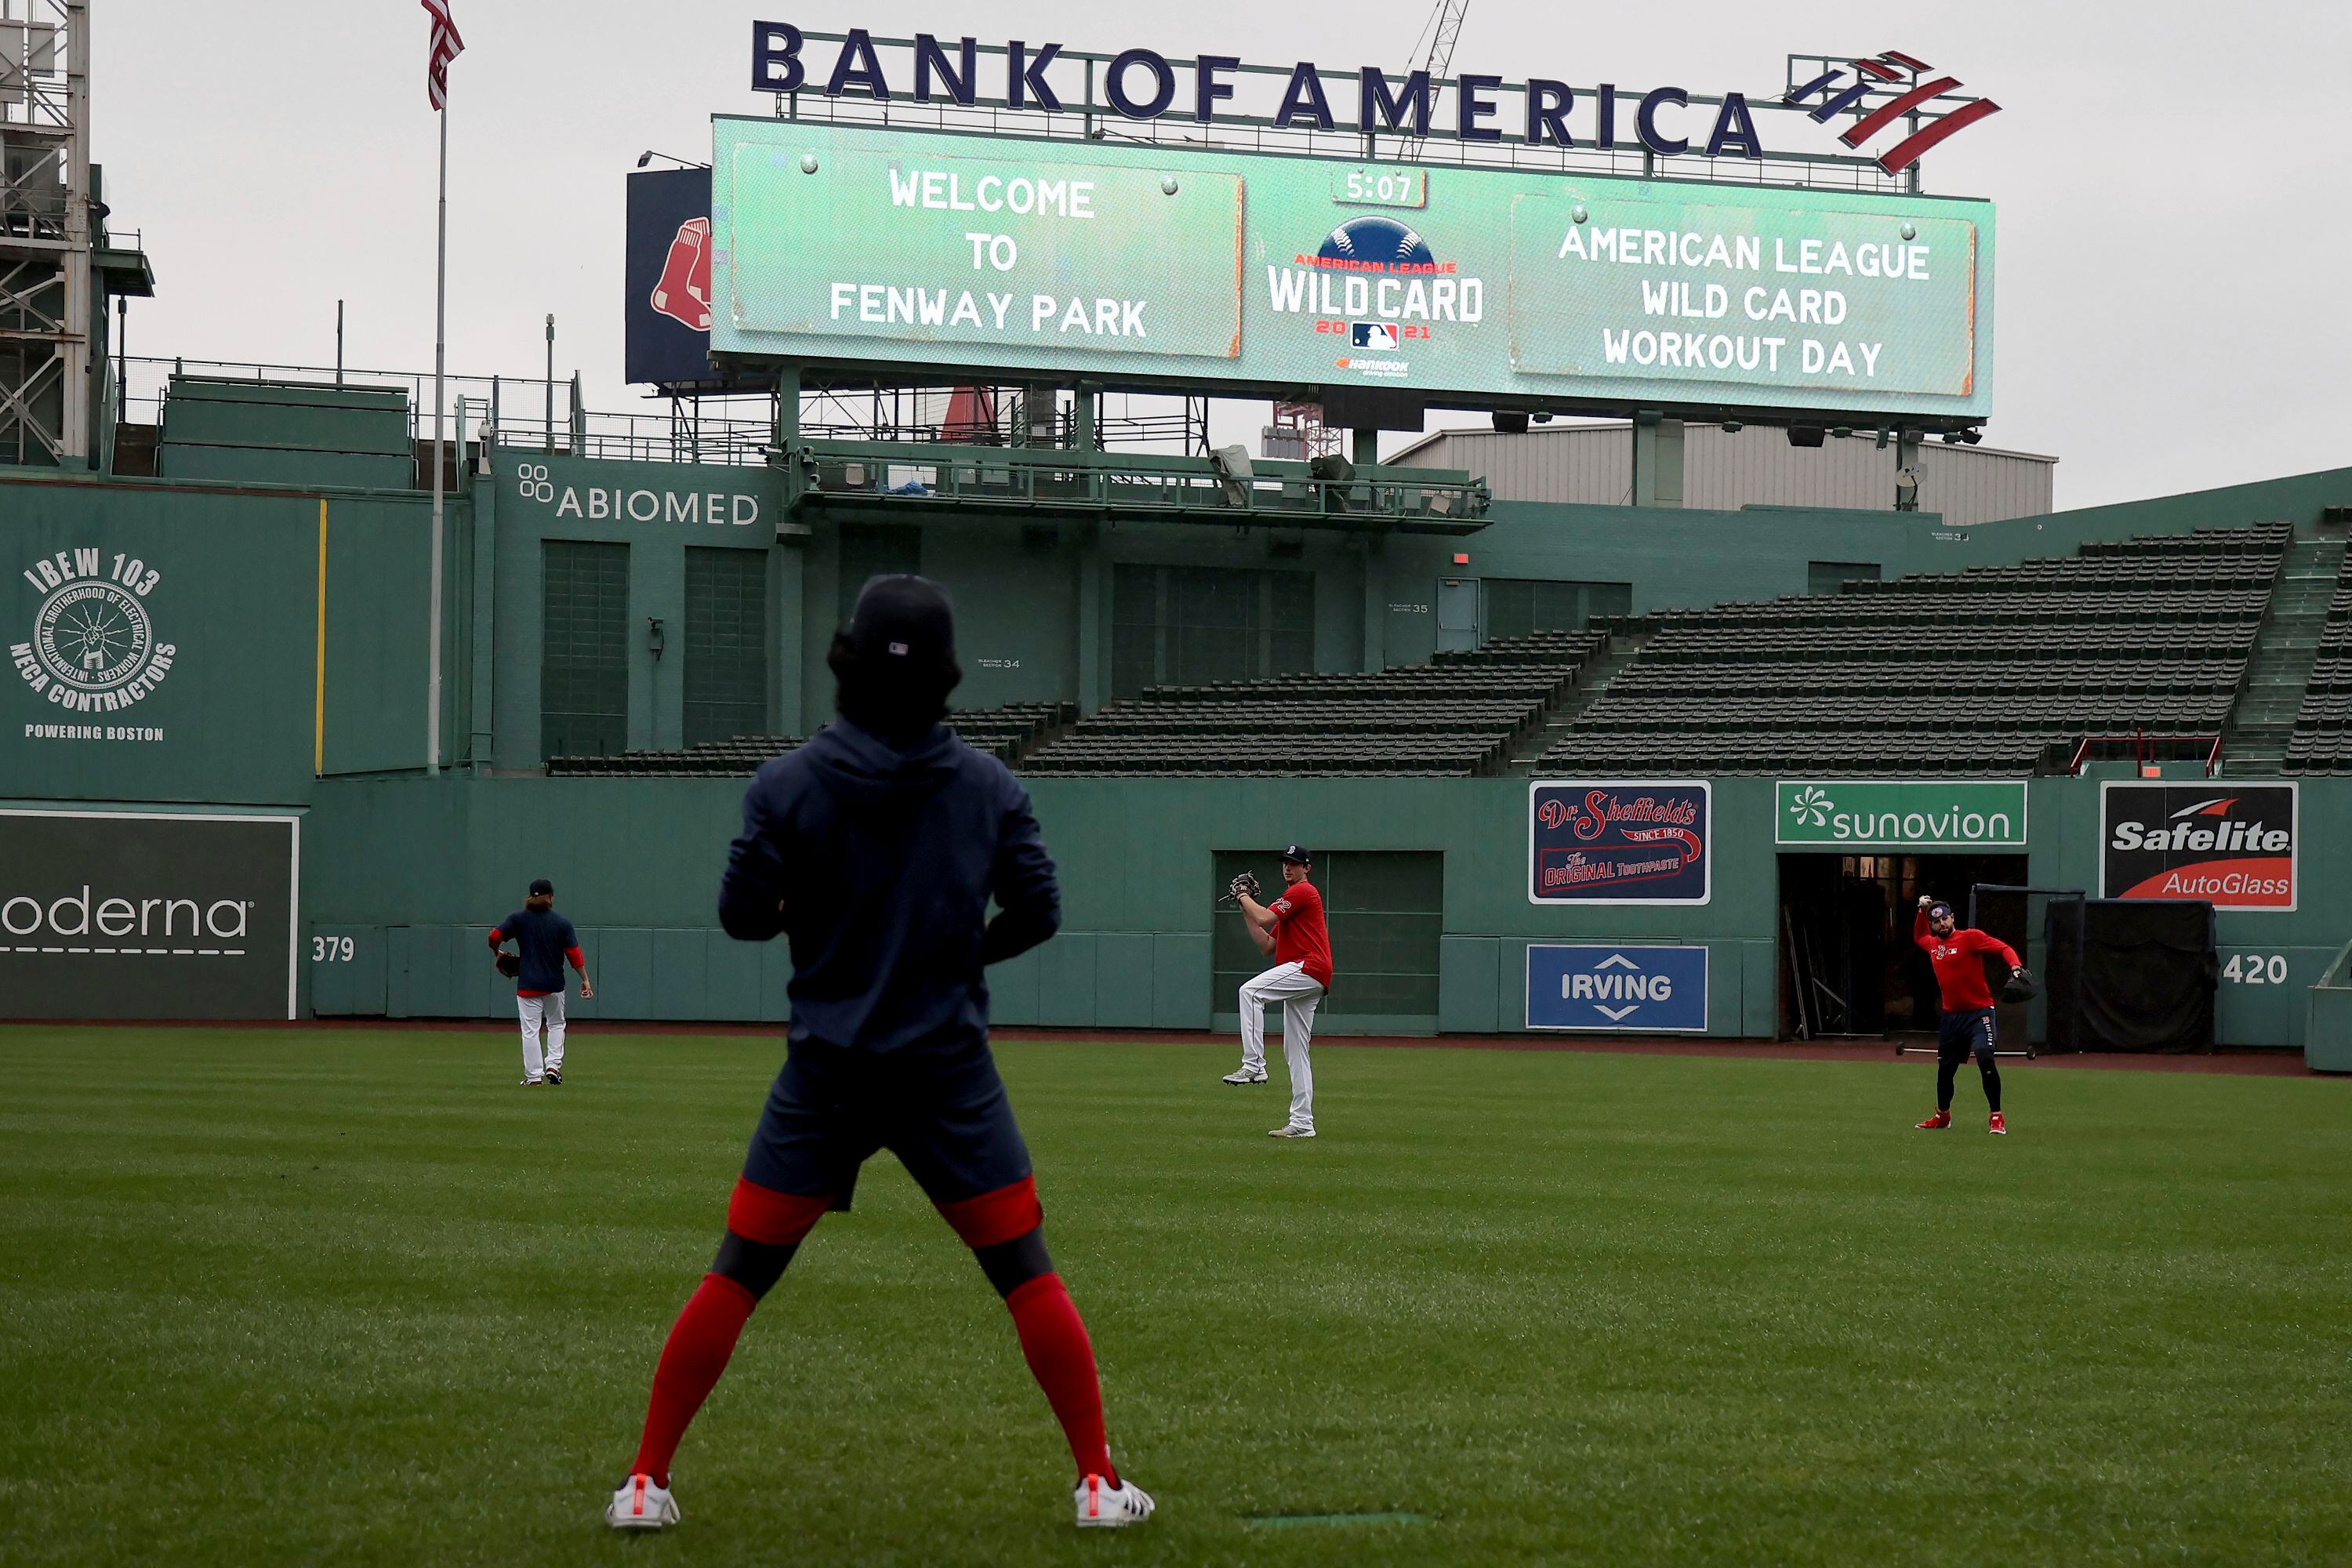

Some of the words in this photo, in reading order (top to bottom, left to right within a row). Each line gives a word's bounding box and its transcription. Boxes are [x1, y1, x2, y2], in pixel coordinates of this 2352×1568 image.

[751, 20, 1064, 114] BANK
[1103, 48, 1241, 124] OF
[1272, 61, 1764, 160] AMERICA
[889, 169, 1094, 219] WELCOME
[1347, 173, 1411, 201] 5:07
[965, 232, 1017, 271] TO
[1294, 254, 1385, 273] AMERICAN
[1389, 262, 1457, 274] LEAGUE
[1558, 225, 1761, 270] AMERICAN
[1776, 238, 1929, 280] LEAGUE
[830, 282, 1014, 329] FENWAY
[1032, 295, 1148, 337] PARK
[1267, 264, 1369, 316] WILD
[1377, 278, 1483, 323] CARD
[1642, 280, 1728, 318] WILD
[1744, 286, 1847, 325] CARD
[1315, 320, 1346, 334] 20
[1404, 325, 1431, 339] 21
[1603, 328, 1786, 372] WORKOUT
[1803, 339, 1882, 377] DAY
[556, 486, 759, 525] ABIOMED
[24, 548, 99, 594] IBEW
[111, 553, 161, 596] 103
[44, 588, 105, 624] BROTHERHOOD
[107, 592, 121, 604] OF
[118, 600, 145, 650] ELECTRICAL
[42, 625, 89, 682] INTERNATIONAL
[97, 651, 140, 682] WORKERS
[1004, 659, 1020, 668] 34
[9, 642, 50, 693] NECA
[48, 642, 176, 713] CONTRACTORS
[25, 724, 102, 739] POWERING
[107, 727, 164, 741] BOSTON
[1538, 799, 1578, 829] Dr.
[1573, 790, 1697, 840] Sheffield's
[1833, 804, 2009, 839] sunovion
[1634, 829, 1660, 840] SINCE
[1664, 828, 1684, 838] 1850
[2111, 820, 2290, 852] Safelite
[1545, 862, 1616, 886] ORIGINAL
[1566, 851, 1587, 869] The
[2161, 873, 2288, 895] AutoGlass
[311, 936, 354, 962] 379
[1562, 973, 1671, 1001] IRVING
[2223, 954, 2288, 985] 420
